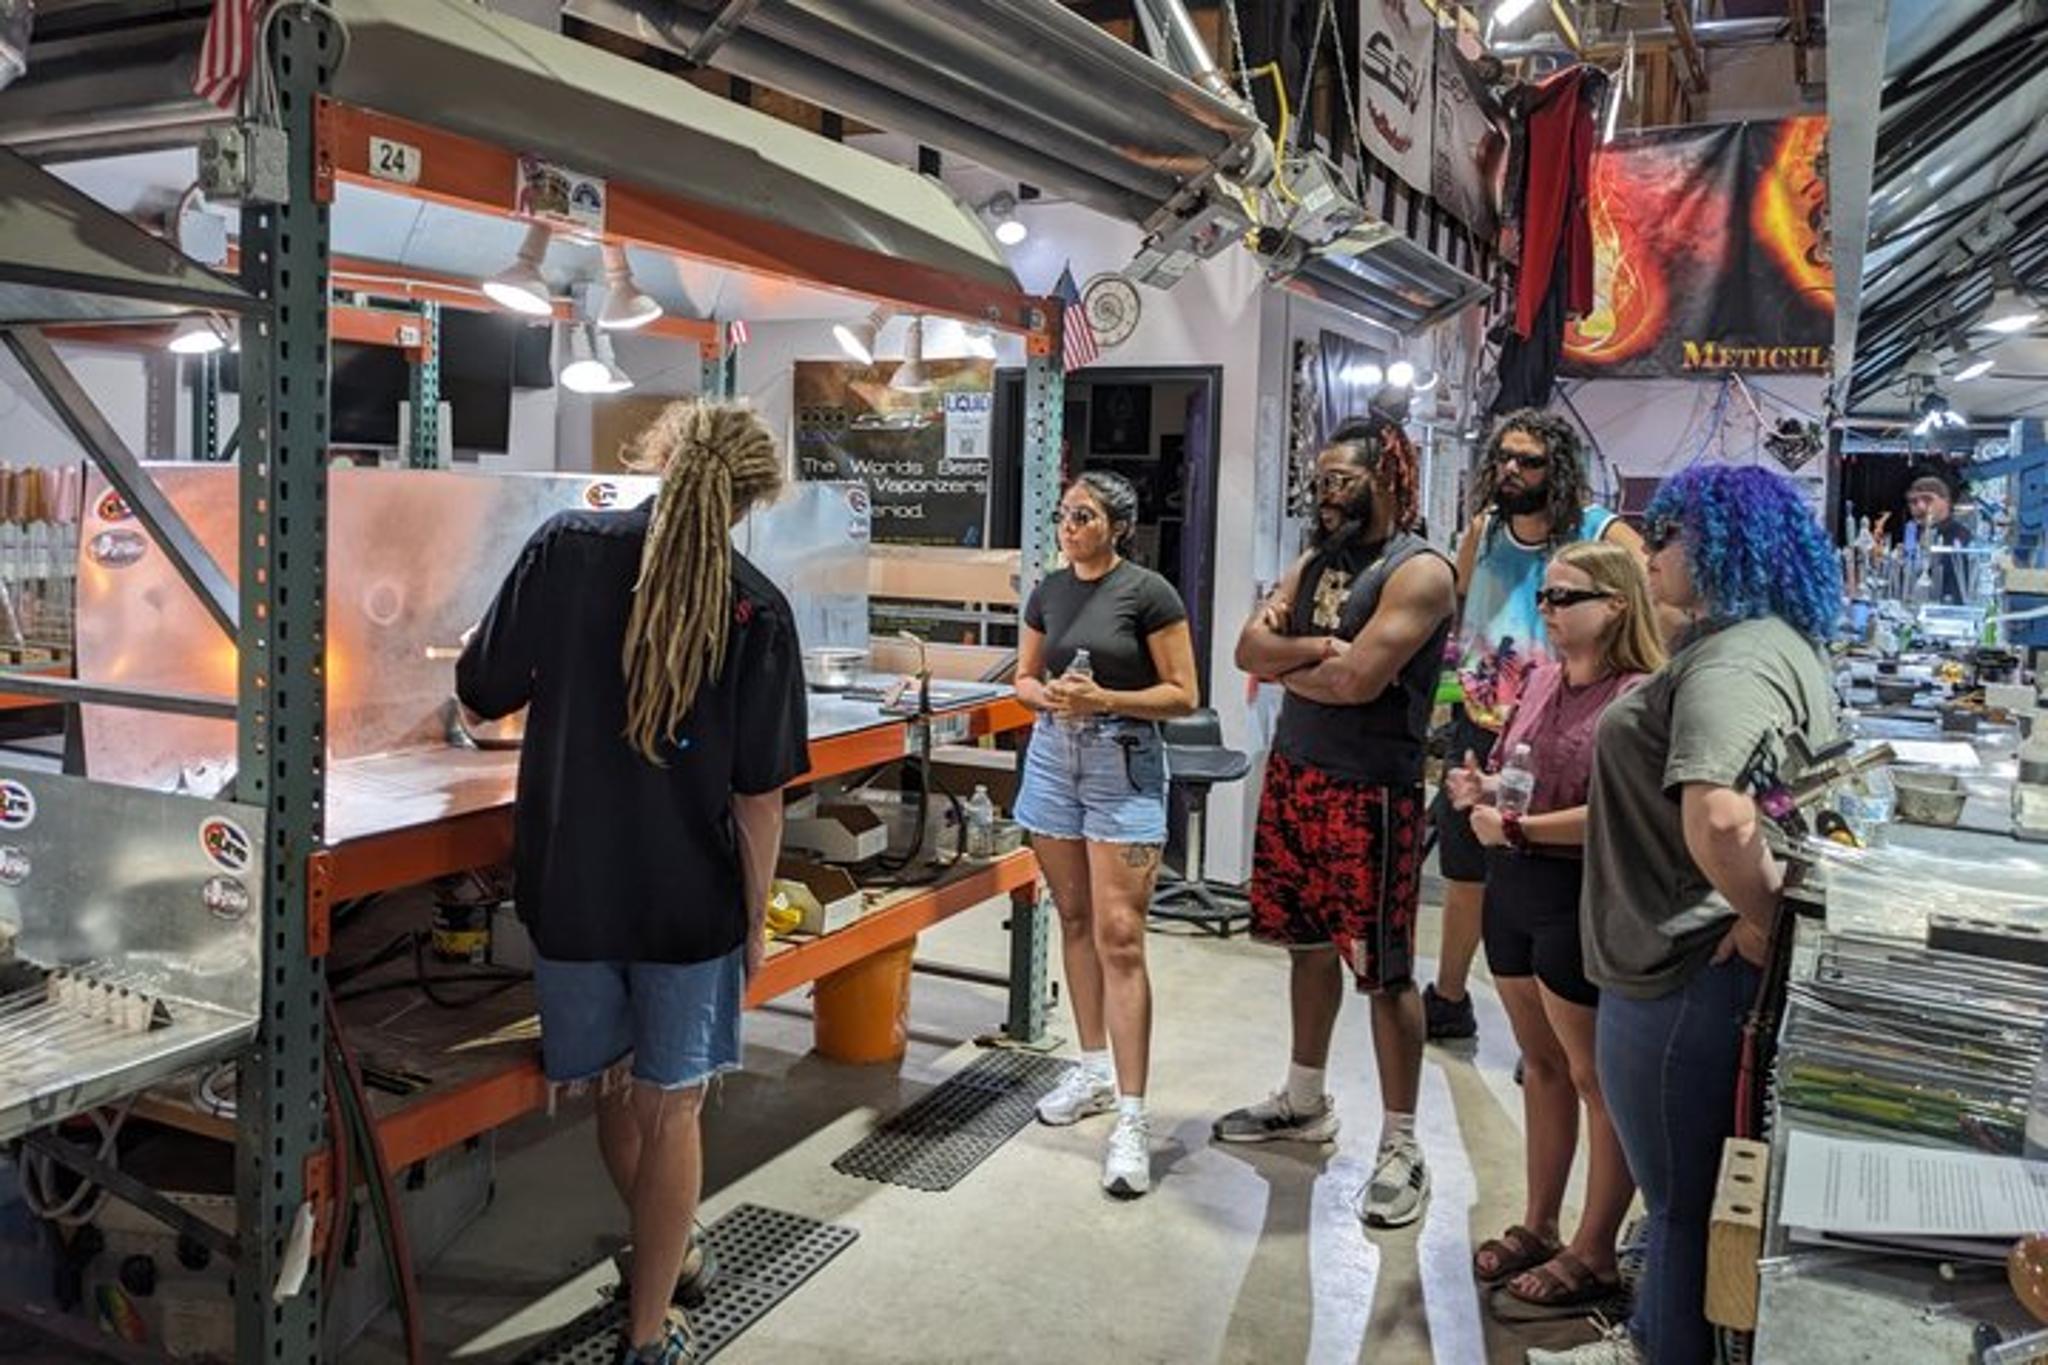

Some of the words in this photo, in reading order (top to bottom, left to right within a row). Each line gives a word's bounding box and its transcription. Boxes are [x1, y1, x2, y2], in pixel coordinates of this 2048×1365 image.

[379, 144, 406, 172] 24
[802, 456, 836, 475] The
[850, 459, 925, 476] Worlds
[937, 460, 990, 476] Best
[873, 477, 987, 496] Vaporizers
[870, 502, 926, 519] eriod.
